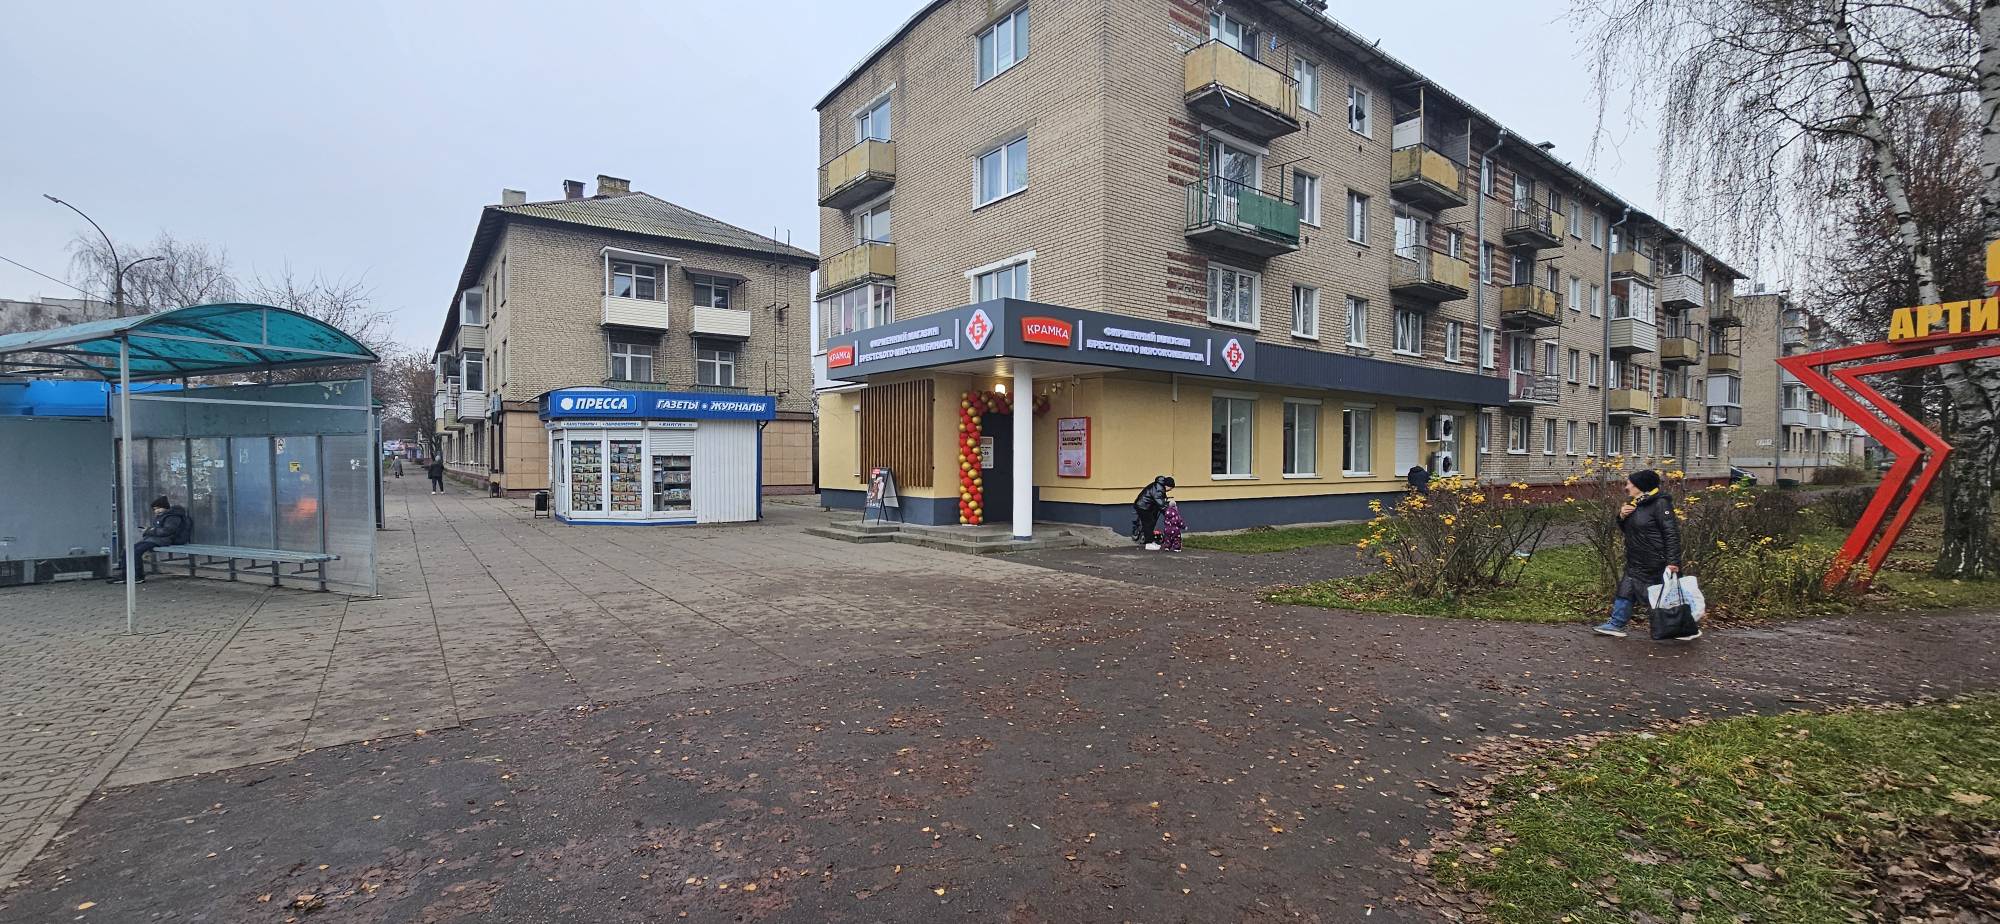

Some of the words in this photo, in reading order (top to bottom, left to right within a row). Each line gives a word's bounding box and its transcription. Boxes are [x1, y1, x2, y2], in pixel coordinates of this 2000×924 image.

[973, 323, 982, 335] Б
[1027, 324, 1069, 340] КРАМКА
[1103, 326, 1156, 343] ФИРМЕННЫЙ
[1156, 334, 1191, 348] МАГАЗИН
[829, 350, 851, 363] КРАМКА
[859, 349, 895, 363] БРЕСТСКОГО
[894, 338, 953, 357] МЯСОКОМБИНАТА
[1086, 338, 1140, 354] БРЕСТСКОГО
[1139, 346, 1205, 362] МЯСОКОМБИНАТА
[575, 397, 628, 410] ПРЕССА
[656, 399, 699, 411] ГАЗЕТЫ
[710, 401, 767, 412] ЖУРНАЛЫ
